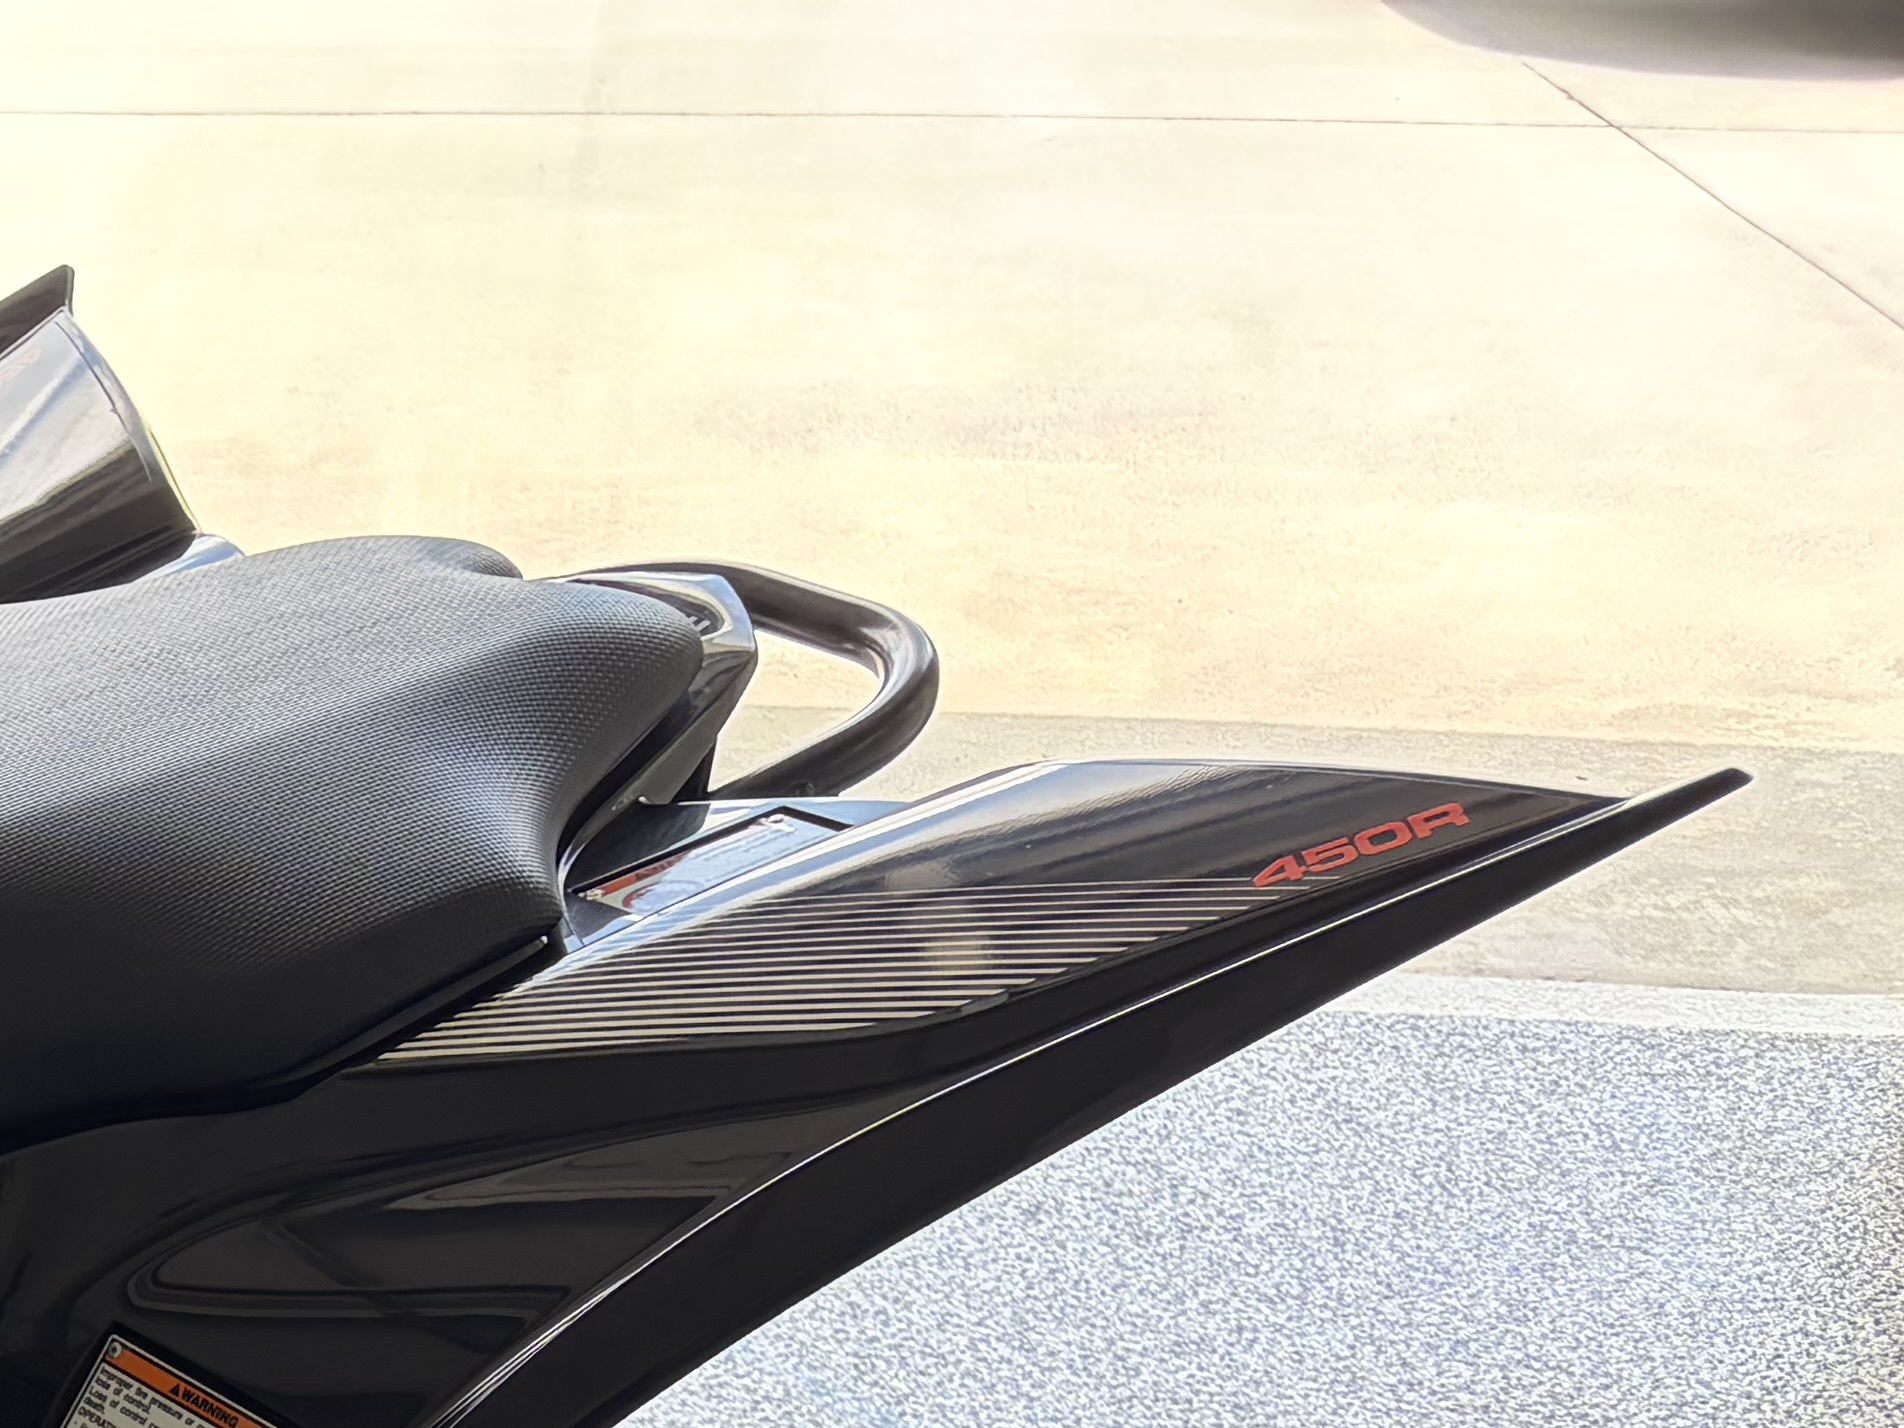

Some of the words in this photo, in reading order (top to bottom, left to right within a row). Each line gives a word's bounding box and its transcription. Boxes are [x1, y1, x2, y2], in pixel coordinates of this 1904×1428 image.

[1253, 802, 1470, 887] 450R
[88, 1385, 107, 1403] Loss
[108, 1399, 120, 1409] of
[119, 1405, 148, 1425] control
[99, 1365, 133, 1390] Improper
[148, 1396, 183, 1420] pressure
[184, 1417, 195, 1426] or
[112, 1385, 123, 1396] of
[181, 1386, 239, 1428] WARNING
